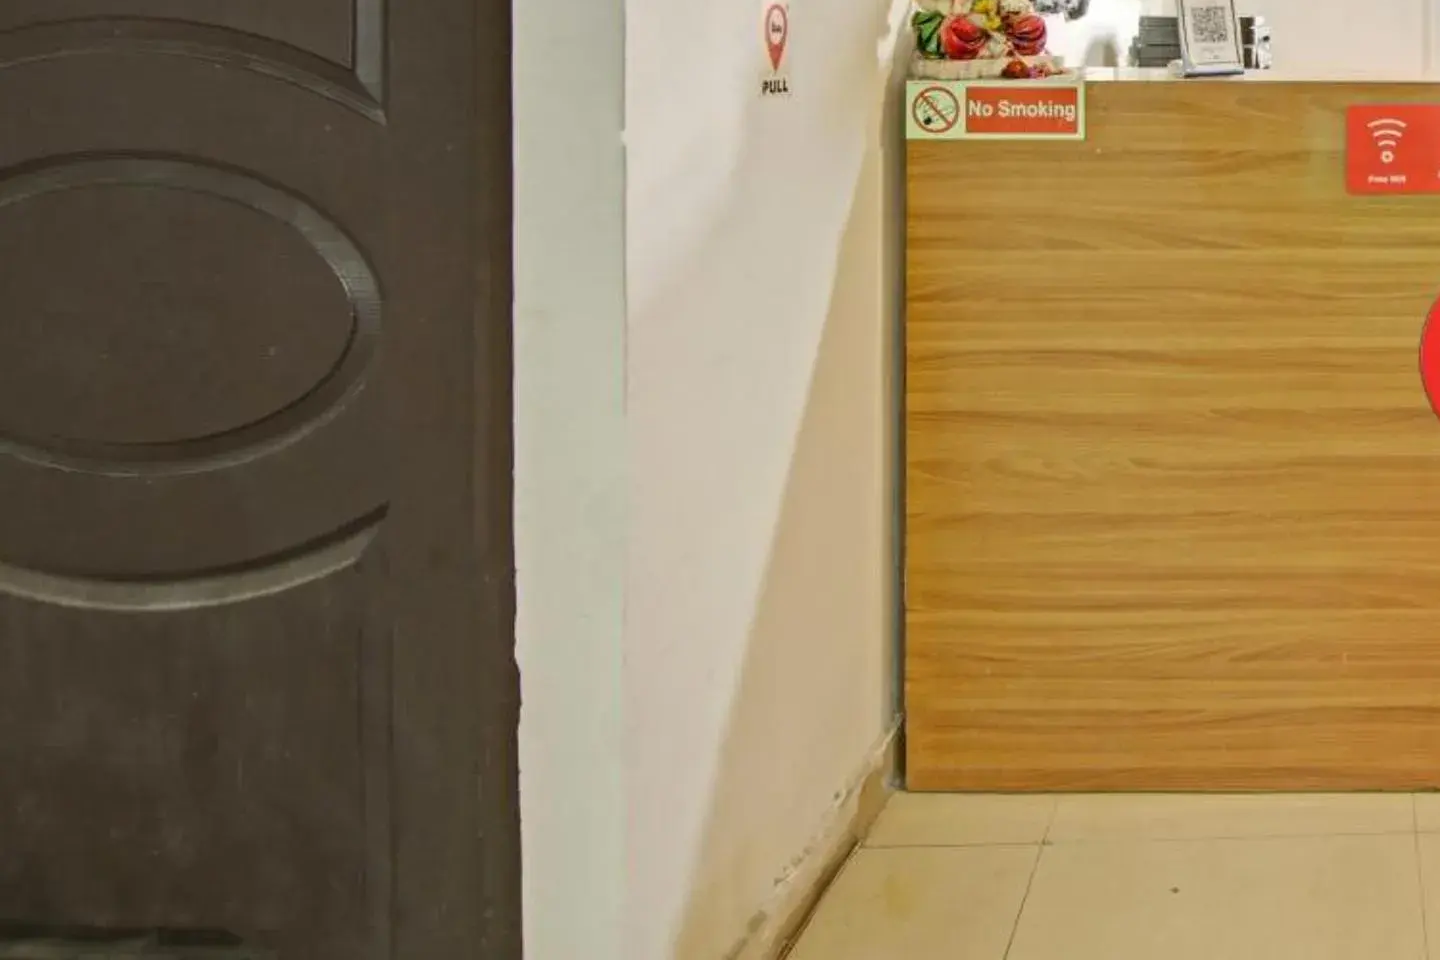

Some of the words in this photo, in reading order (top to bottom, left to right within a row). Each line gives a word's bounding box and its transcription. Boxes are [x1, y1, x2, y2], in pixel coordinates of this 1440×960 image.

[762, 78, 788, 95] PULL
[968, 100, 993, 117] No
[998, 99, 1076, 121] Smoking
